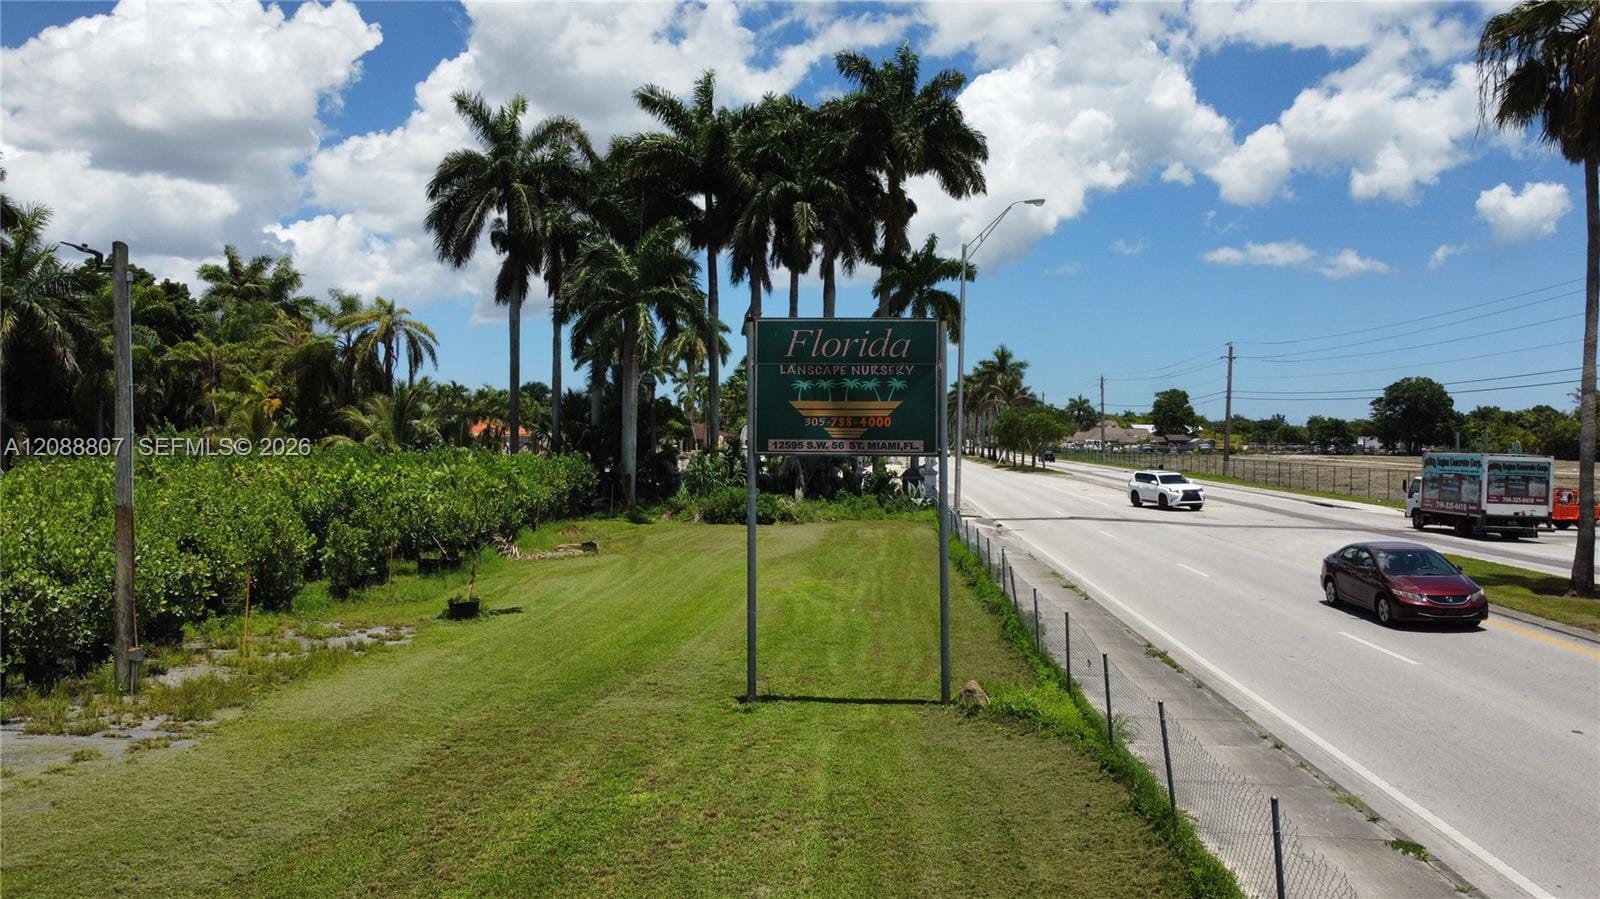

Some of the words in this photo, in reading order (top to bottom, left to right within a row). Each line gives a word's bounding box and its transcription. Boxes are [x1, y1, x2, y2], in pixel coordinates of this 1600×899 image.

[784, 328, 912, 358] Florida
[780, 364, 847, 375] LANSCAPE
[771, 441, 804, 450] 12595
[806, 441, 829, 450] S.W.
[832, 441, 845, 450] 56
[849, 440, 865, 450] ST.
